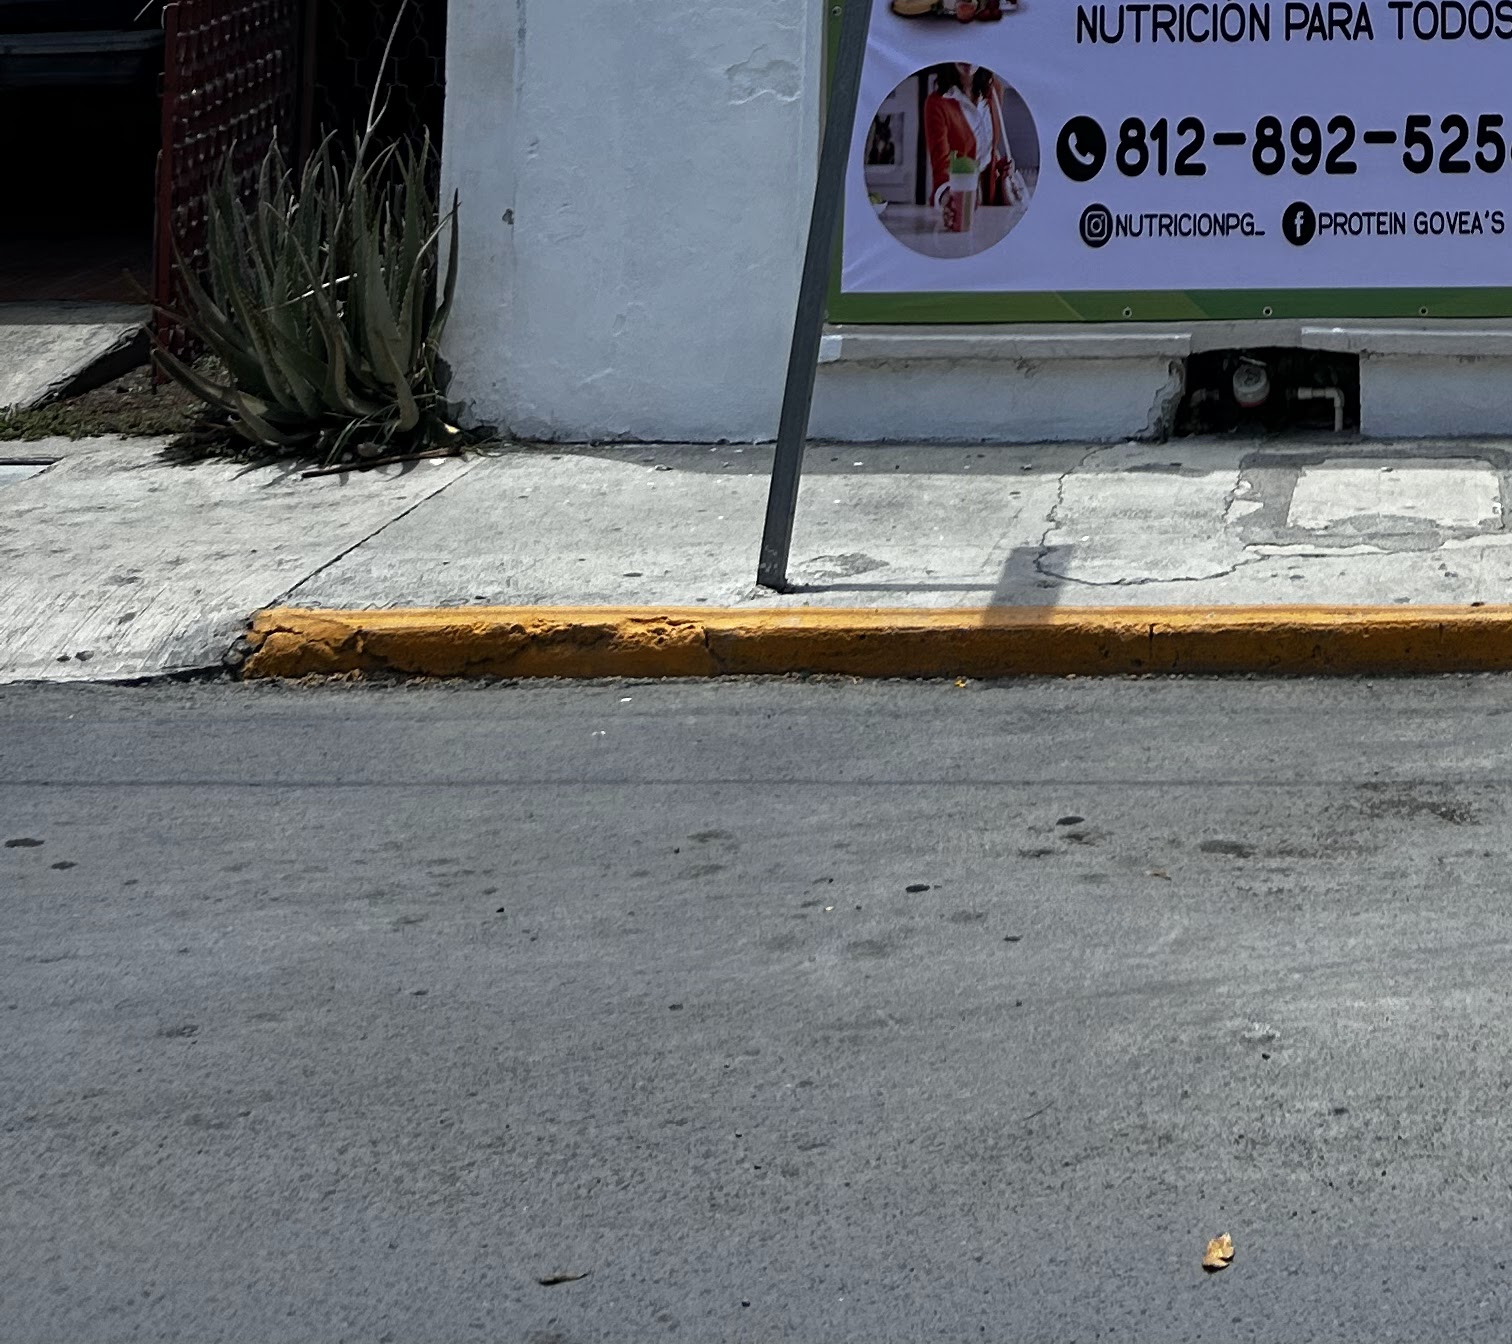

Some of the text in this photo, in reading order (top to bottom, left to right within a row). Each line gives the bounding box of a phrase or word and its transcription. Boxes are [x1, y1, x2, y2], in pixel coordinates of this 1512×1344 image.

[1284, 1, 1374, 42] PARA
[1318, 209, 1505, 236] PROTEIN GOVEA'S
